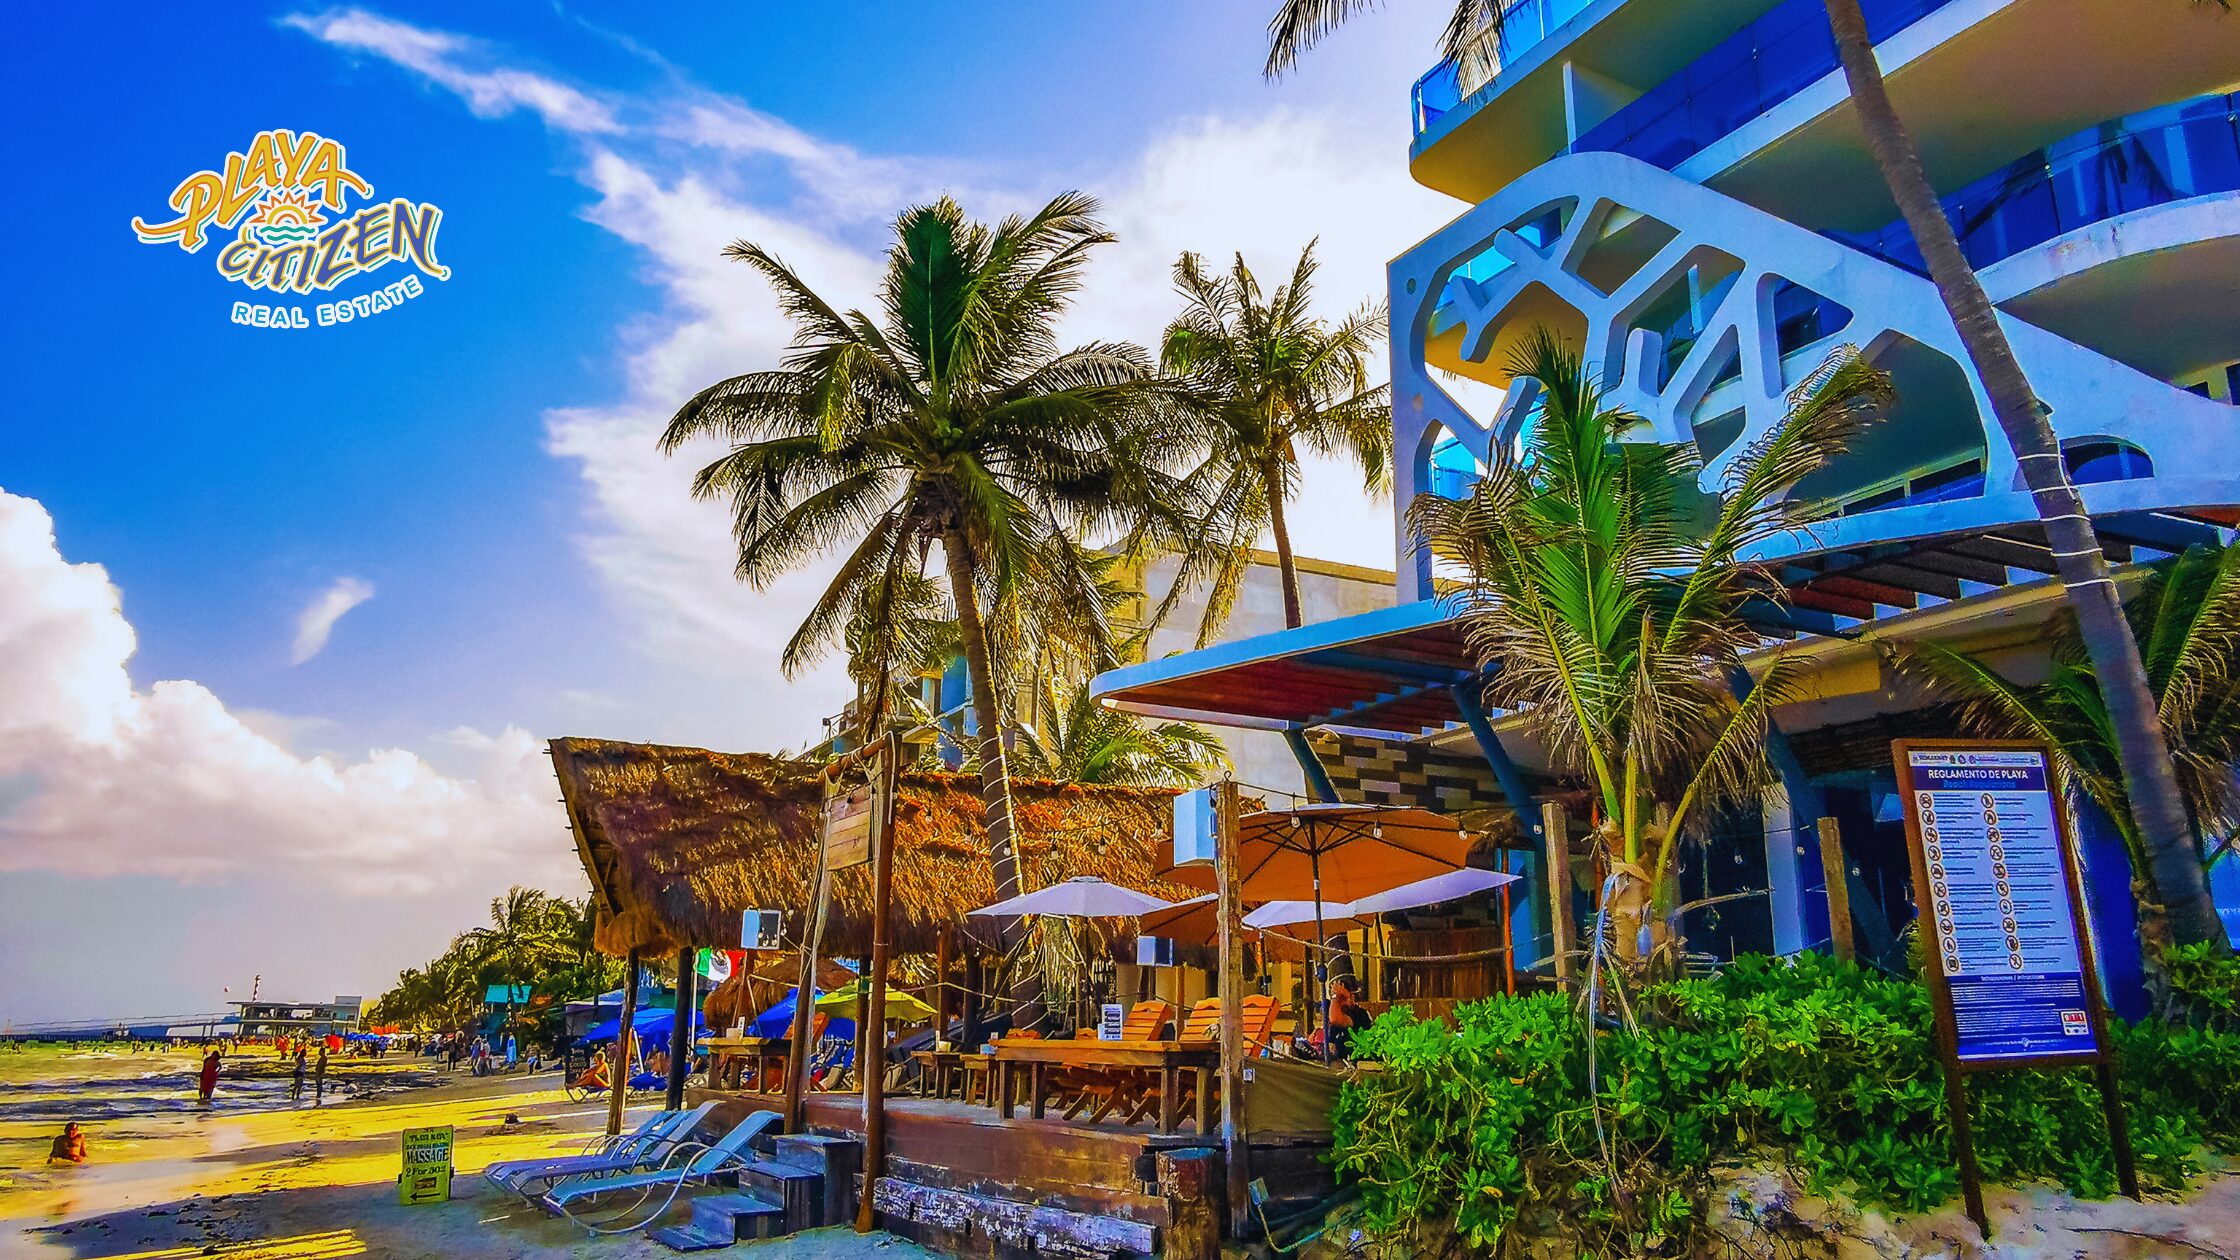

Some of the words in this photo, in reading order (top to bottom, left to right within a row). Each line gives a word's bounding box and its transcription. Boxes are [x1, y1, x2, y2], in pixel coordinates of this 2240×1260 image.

[1928, 769, 1986, 779] REGLAMENTO
[1988, 770, 2001, 779] DE
[2001, 769, 2029, 779] PLAYA
[406, 1148, 449, 1164] MASSAGE
[412, 1168, 427, 1176] For
